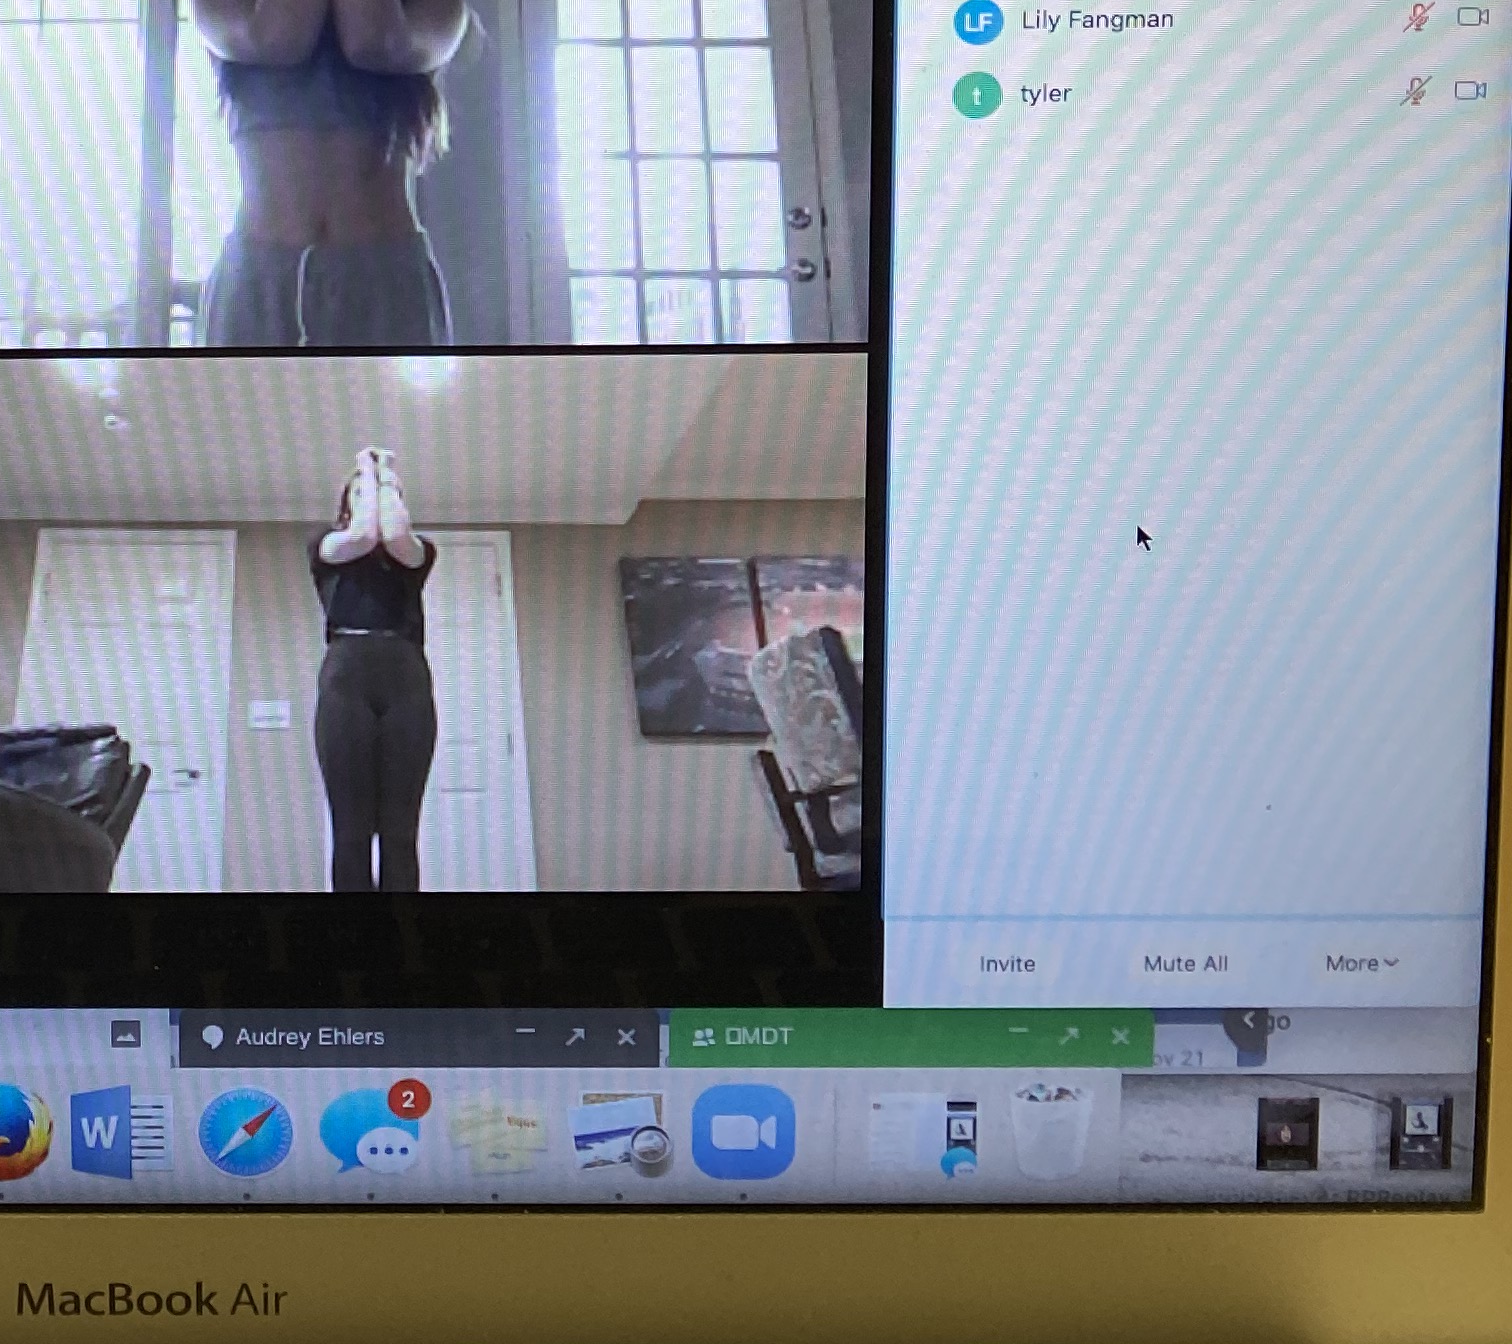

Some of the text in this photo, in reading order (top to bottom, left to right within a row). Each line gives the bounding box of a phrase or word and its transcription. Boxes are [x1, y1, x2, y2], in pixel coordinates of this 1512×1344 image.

[963, 12, 993, 32] LF
[1022, 8, 1174, 33] Lily Fangman
[971, 86, 982, 106] t
[1020, 82, 1073, 107] tyler
[980, 956, 1036, 973] Invite
[1144, 955, 1228, 972] Mute All
[1326, 954, 1379, 972] More
[236, 1027, 385, 1050] Audrey Ehlers
[1181, 1050, 1204, 1067] 21
[400, 1089, 417, 1110] 2
[81, 1115, 119, 1149] W
[16, 1280, 288, 1316] MacBook Air
